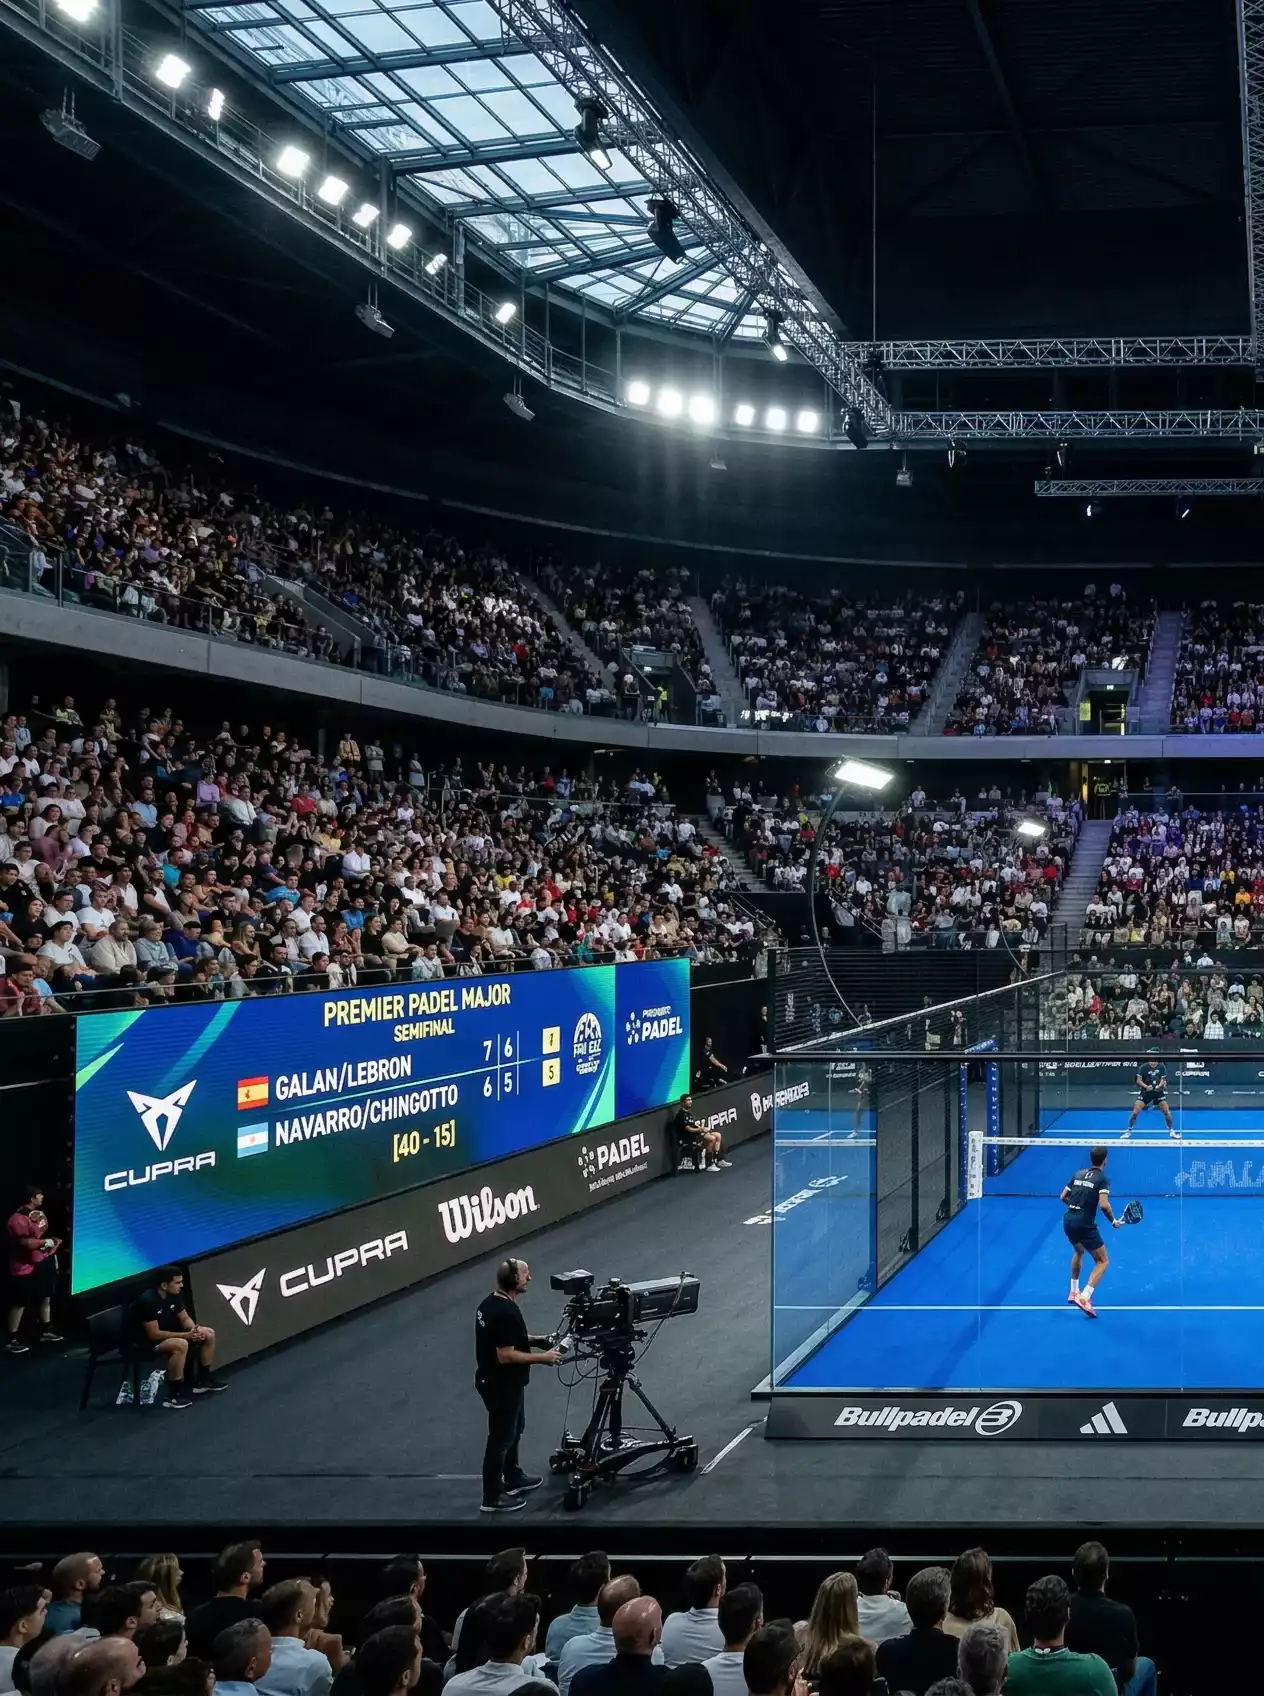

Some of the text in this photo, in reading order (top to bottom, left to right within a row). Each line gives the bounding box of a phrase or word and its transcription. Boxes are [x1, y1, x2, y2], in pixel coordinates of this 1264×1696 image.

[324, 983, 512, 1028] PREMIER PADEL MAJOR
[394, 1017, 456, 1043] SEMIFINAL
[641, 1016, 683, 1042] PADEL
[275, 1037, 513, 1102] GALAN/LEBRON 7 6
[548, 1064, 555, 1080] 5
[275, 1072, 513, 1147] NAVARRO/CHINGOTTO 6 5
[394, 1131, 420, 1163] [40
[434, 1119, 456, 1148] 15]
[596, 1132, 650, 1171] PADEL
[104, 1151, 216, 1192] CUPRA
[438, 1184, 538, 1245] Wilson
[280, 1229, 409, 1300] CUPRA
[834, 1405, 980, 1430] Bullpadel
